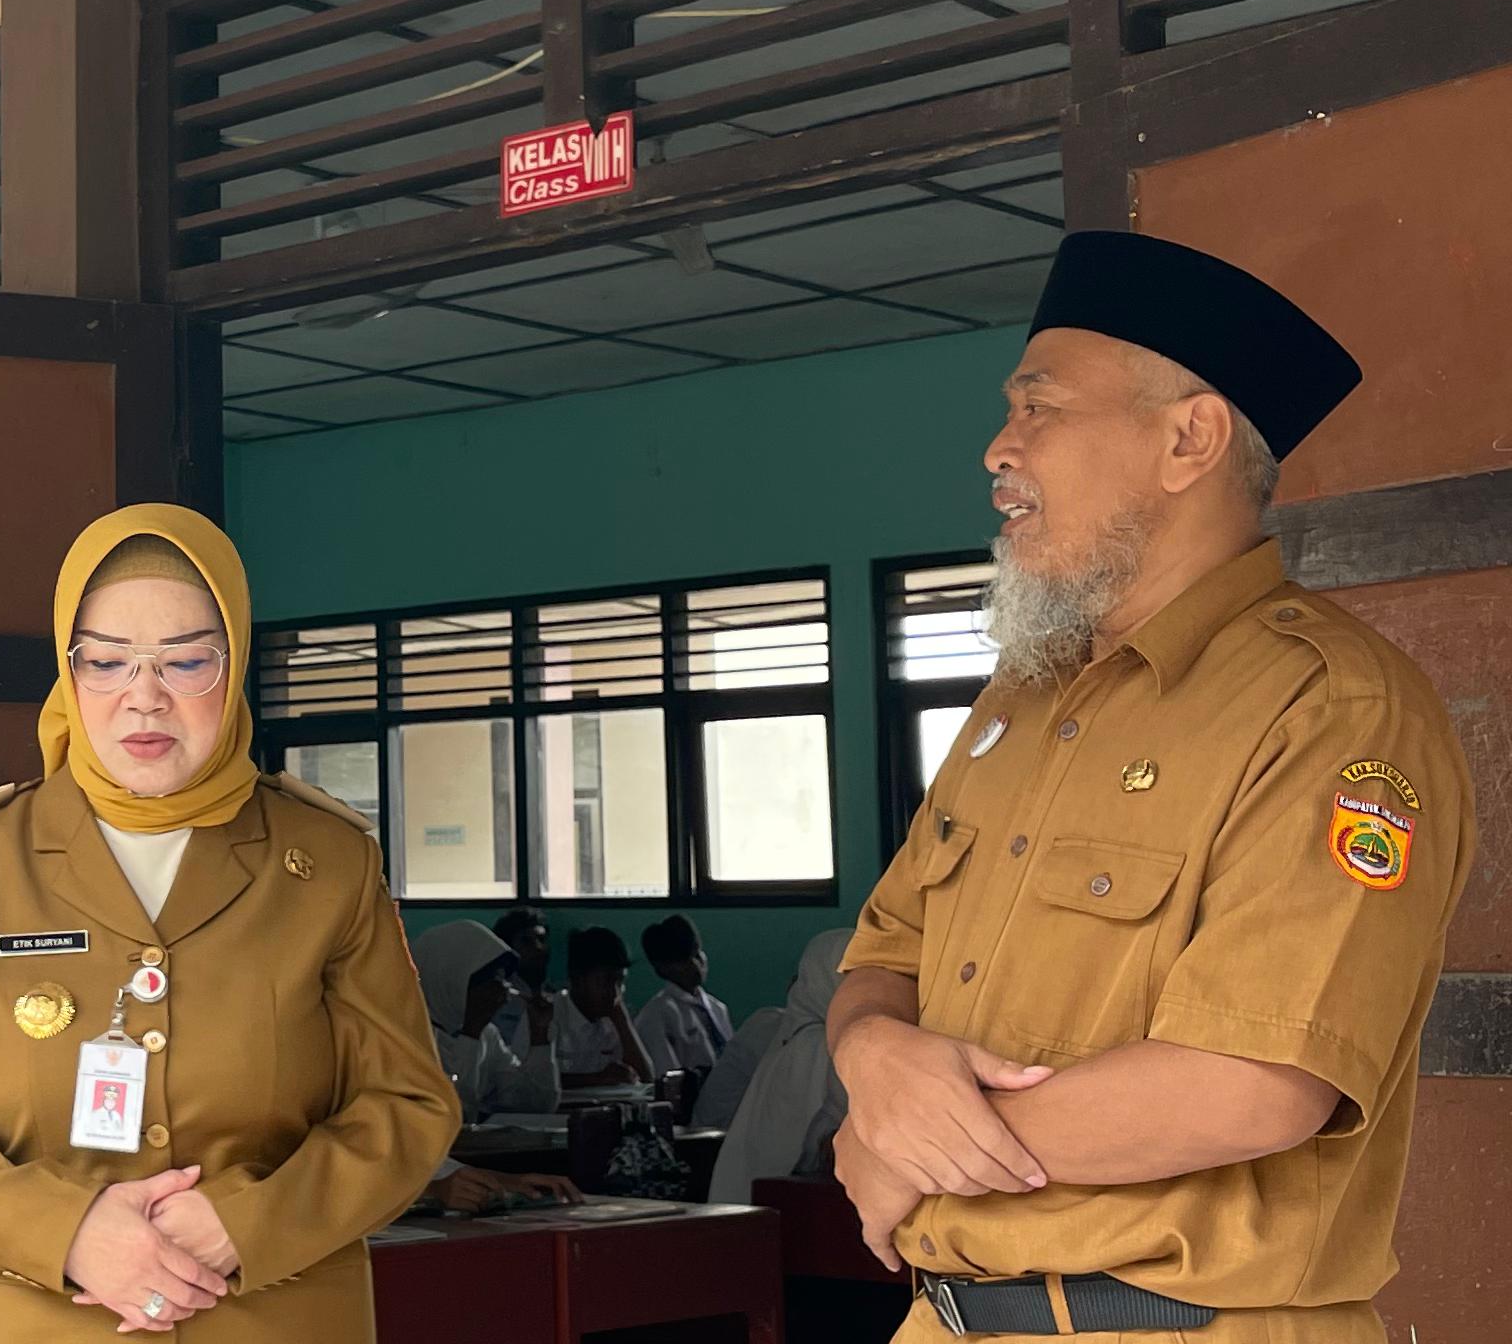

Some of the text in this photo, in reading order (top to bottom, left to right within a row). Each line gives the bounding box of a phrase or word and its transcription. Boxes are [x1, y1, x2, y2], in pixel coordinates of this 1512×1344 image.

[509, 133, 581, 174] KELAS
[612, 127, 625, 178] H
[509, 175, 580, 205] Class
[12, 937, 74, 949] ETIK SURYANI
